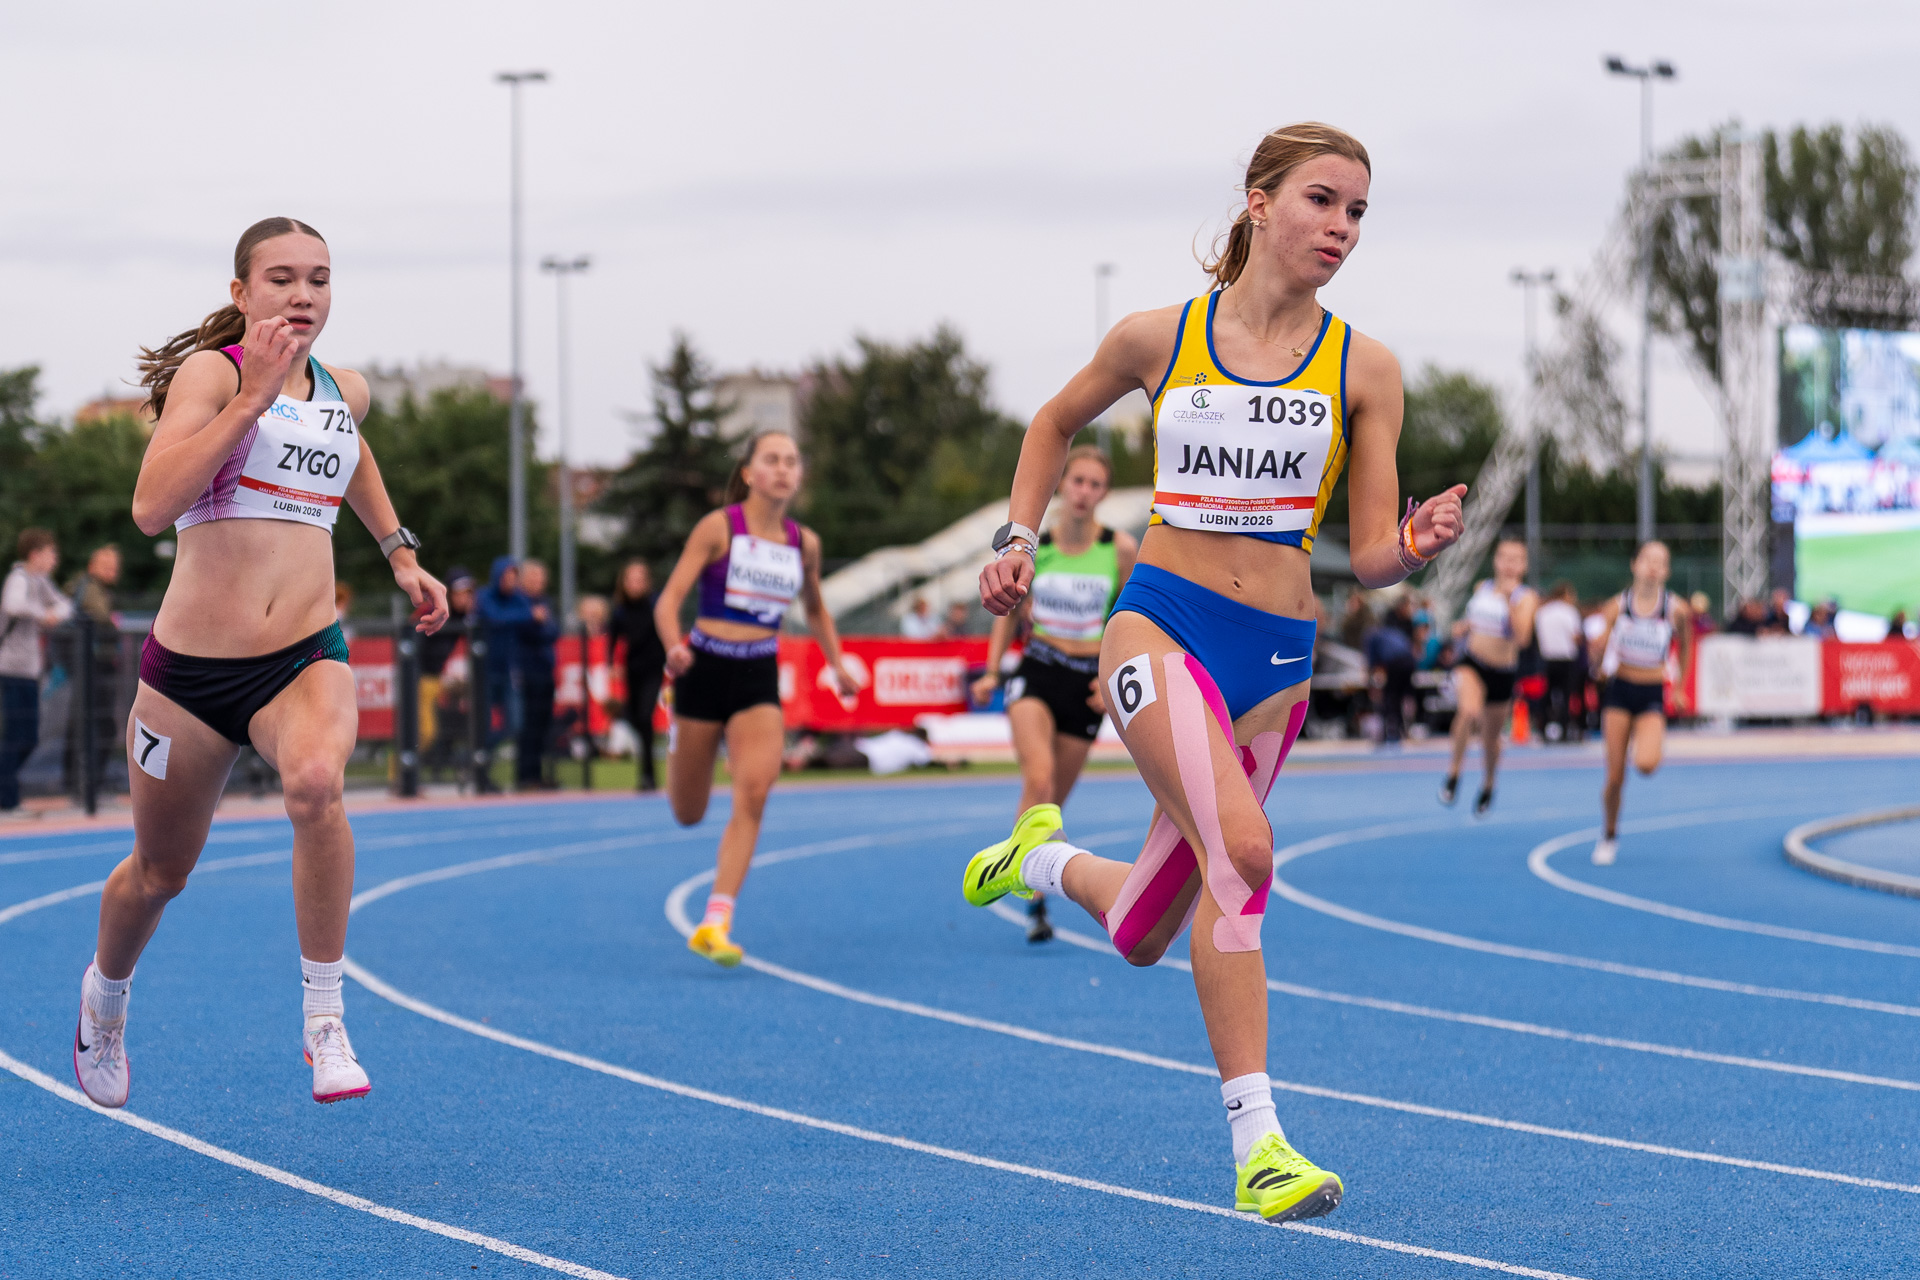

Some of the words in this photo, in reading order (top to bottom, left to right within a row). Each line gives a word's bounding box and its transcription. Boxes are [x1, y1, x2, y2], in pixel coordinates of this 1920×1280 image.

[319, 409, 353, 434] 721
[1173, 410, 1225, 421] CZUBASZEK
[1248, 395, 1327, 427] 1039
[277, 443, 340, 479] ZYGO
[1177, 444, 1308, 480] JANIAK
[273, 500, 302, 514] LUBIN
[302, 506, 322, 517] 2026
[1214, 497, 1250, 505] Mistrzostwa
[1199, 513, 1239, 526] LUBIN
[1241, 515, 1274, 526] 2026
[1117, 664, 1143, 714] 6
[140, 726, 160, 767] 7
